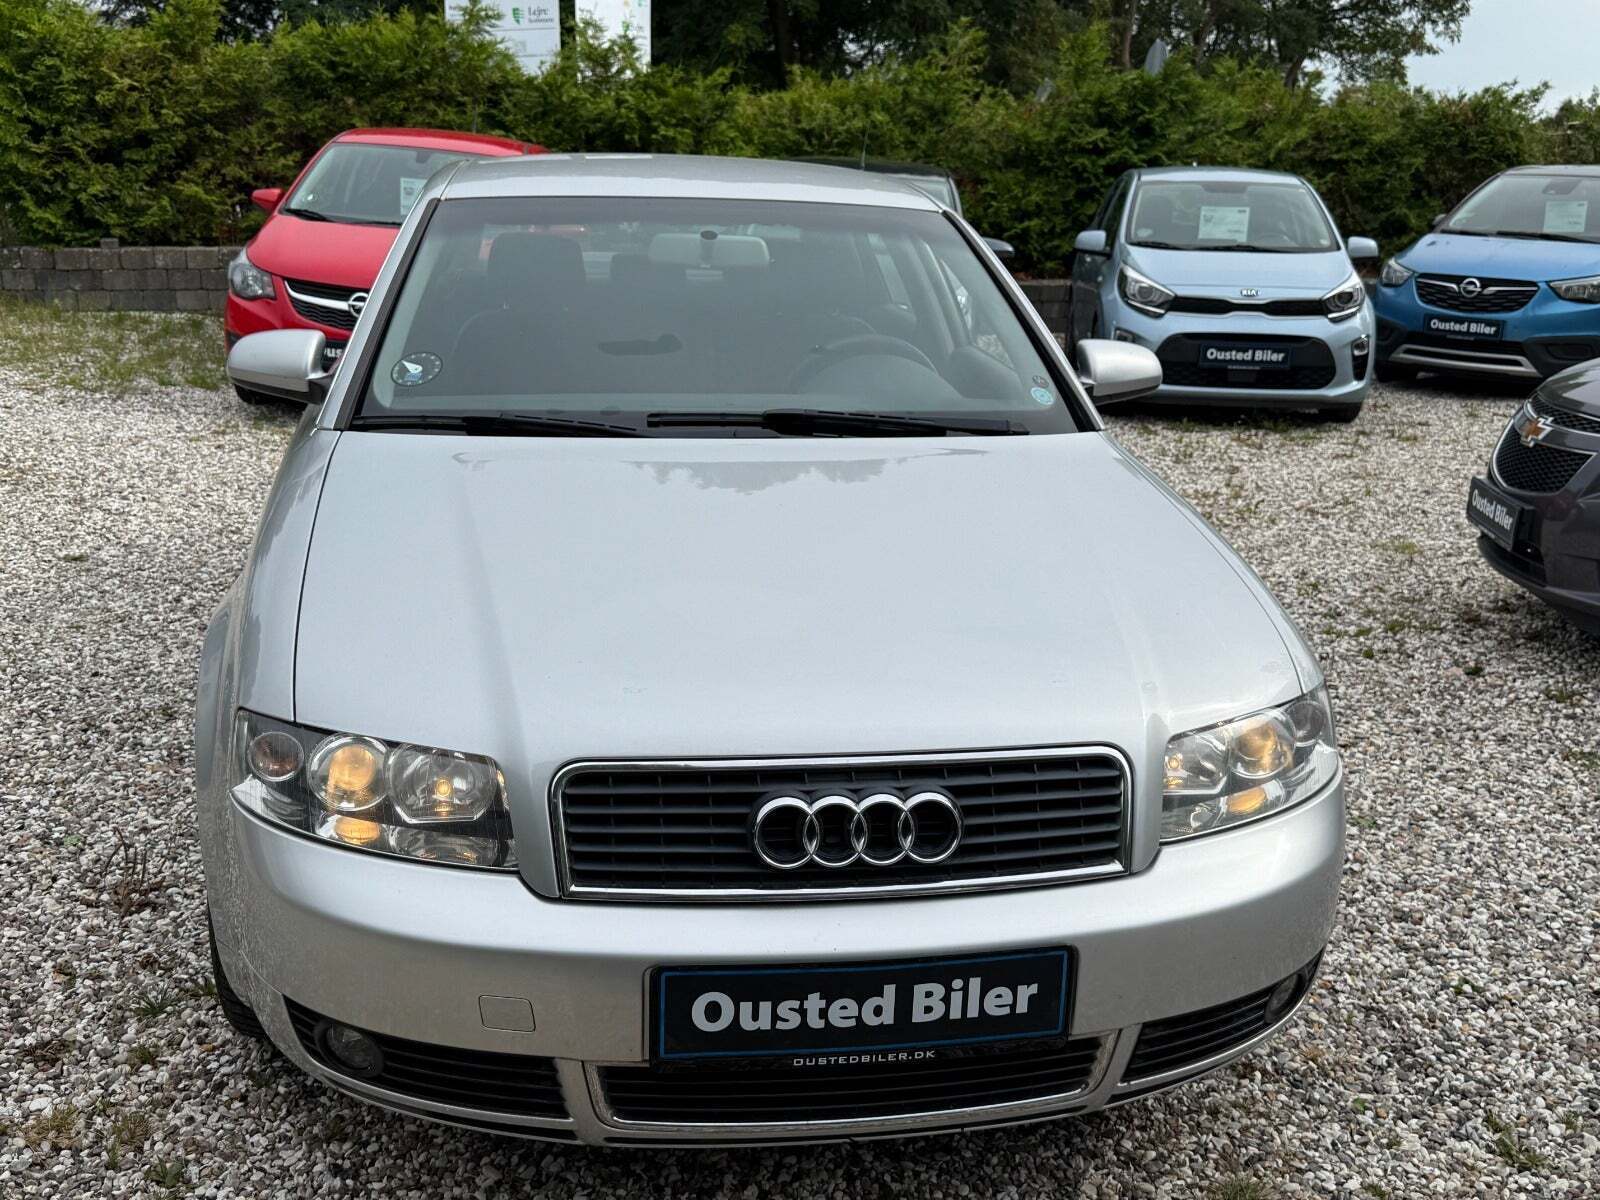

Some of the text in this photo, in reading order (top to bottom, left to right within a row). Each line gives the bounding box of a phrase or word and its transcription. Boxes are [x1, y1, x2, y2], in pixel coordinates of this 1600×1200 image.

[1241, 288, 1257, 297] KIA
[1430, 318, 1497, 334] Ousted Biler
[1206, 348, 1285, 362] Ousted Biler
[1472, 489, 1513, 530] Ousted Biler
[691, 977, 1038, 1033] Ousted Biler
[793, 1050, 936, 1066] OUSTEDBILER.DK
